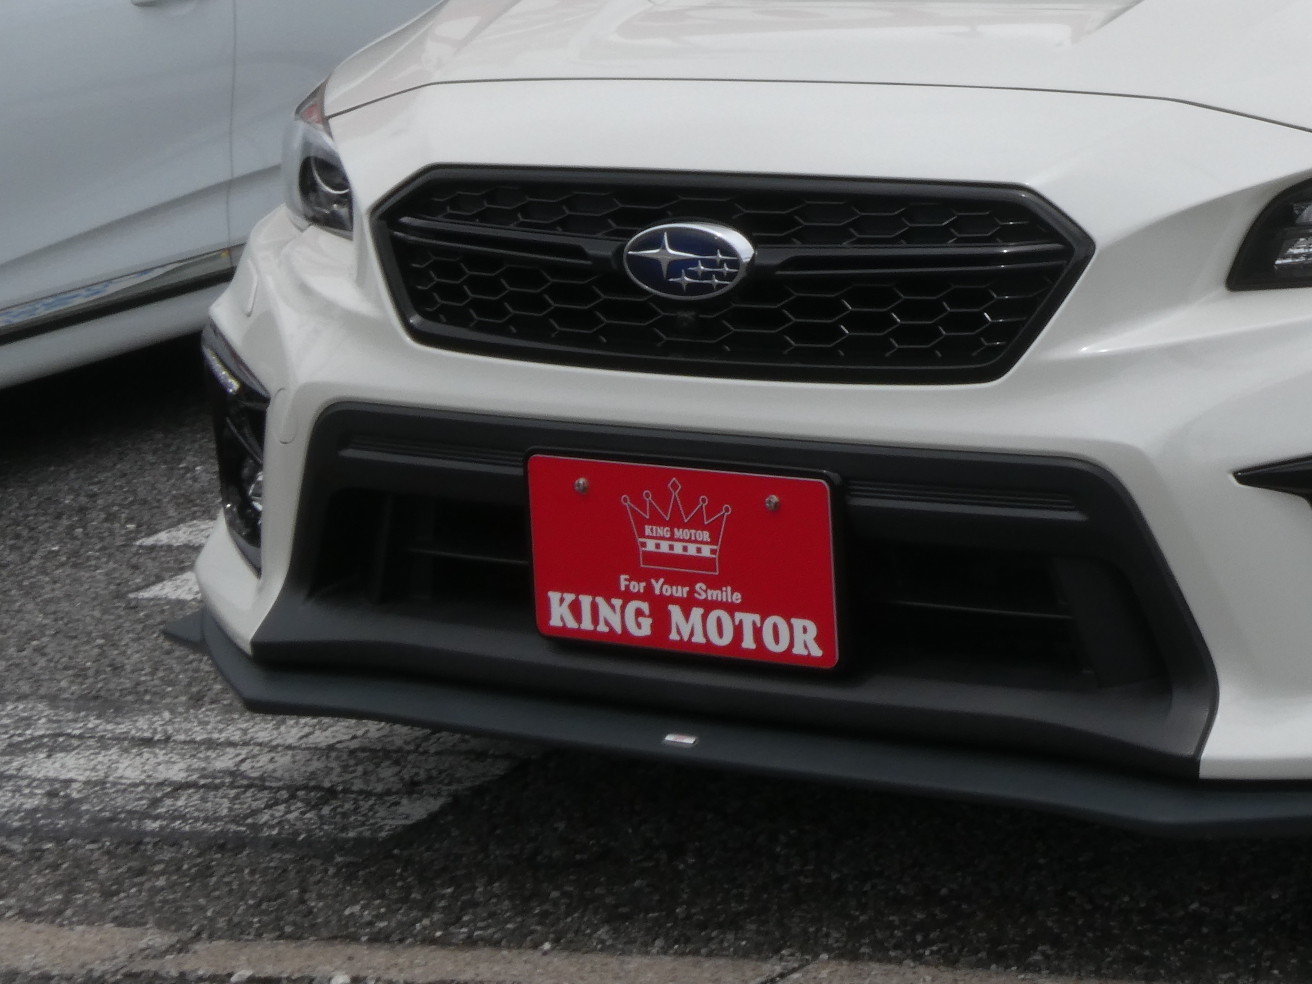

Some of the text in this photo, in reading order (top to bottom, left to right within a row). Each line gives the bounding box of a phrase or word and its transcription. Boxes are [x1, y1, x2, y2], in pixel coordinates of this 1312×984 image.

[644, 524, 711, 543] KING MOTOR
[619, 573, 743, 605] For Your Smile
[547, 590, 824, 658] KING MOTOR
